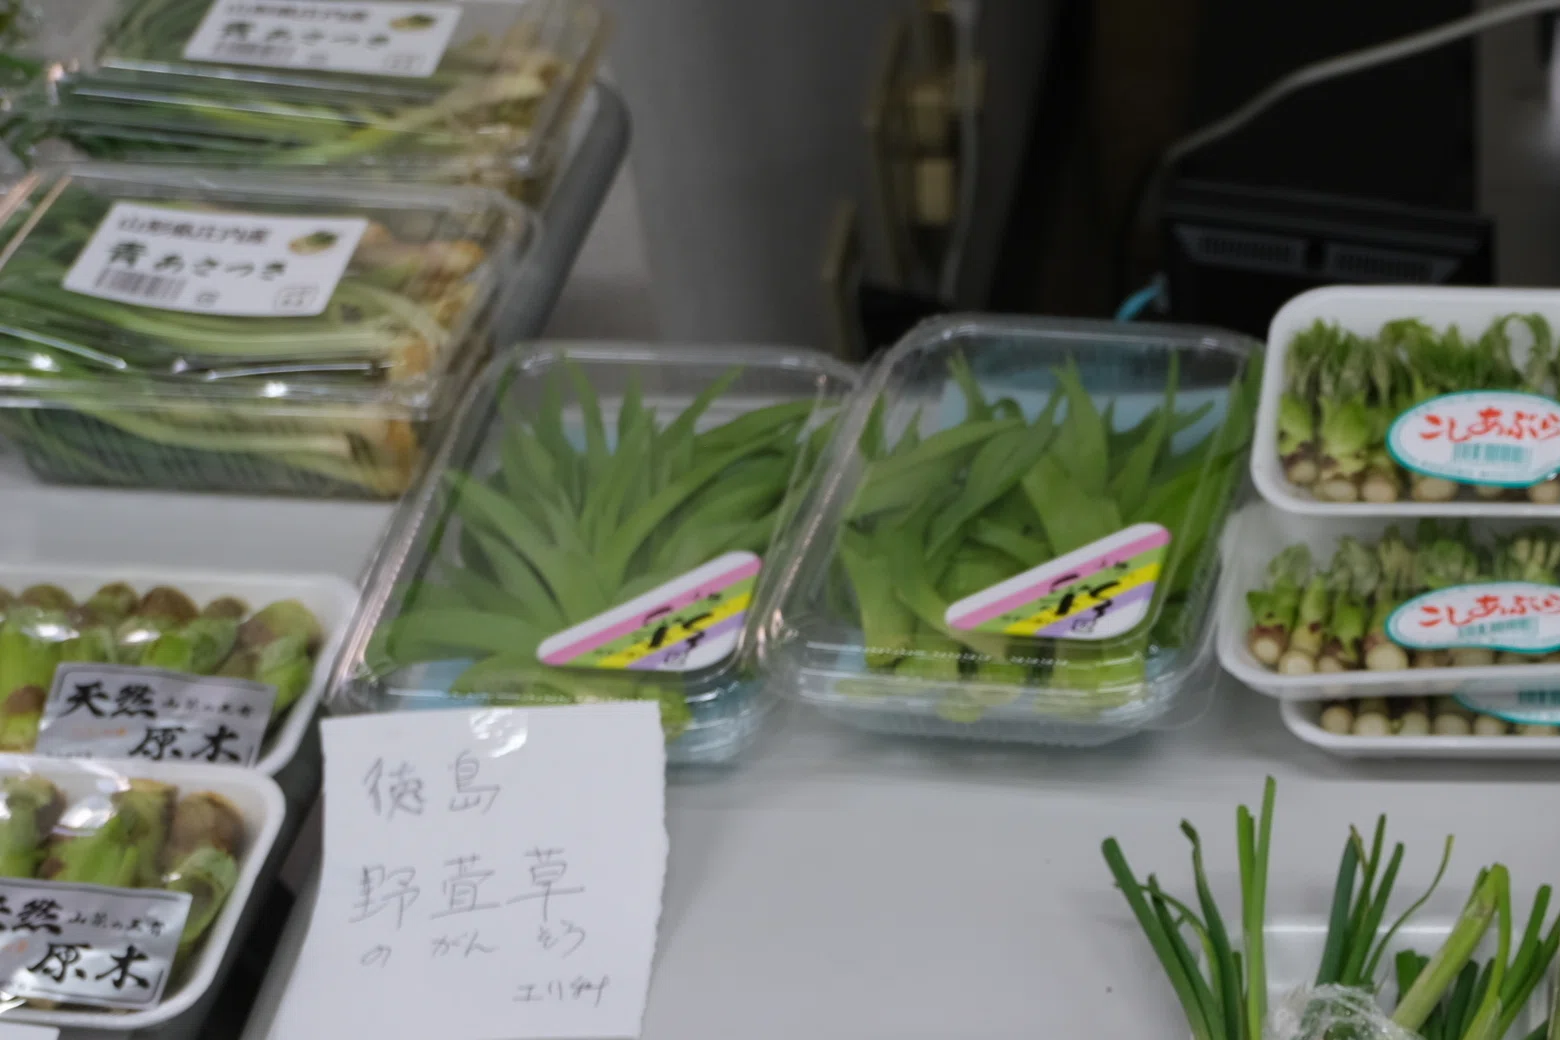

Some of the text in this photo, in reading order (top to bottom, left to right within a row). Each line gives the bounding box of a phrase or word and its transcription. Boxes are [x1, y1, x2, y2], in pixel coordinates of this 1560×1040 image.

[57, 681, 157, 719] 天然
[128, 724, 242, 763] 原木
[362, 749, 501, 822] 徳島
[0, 896, 63, 936] 然
[27, 943, 150, 990] 原木
